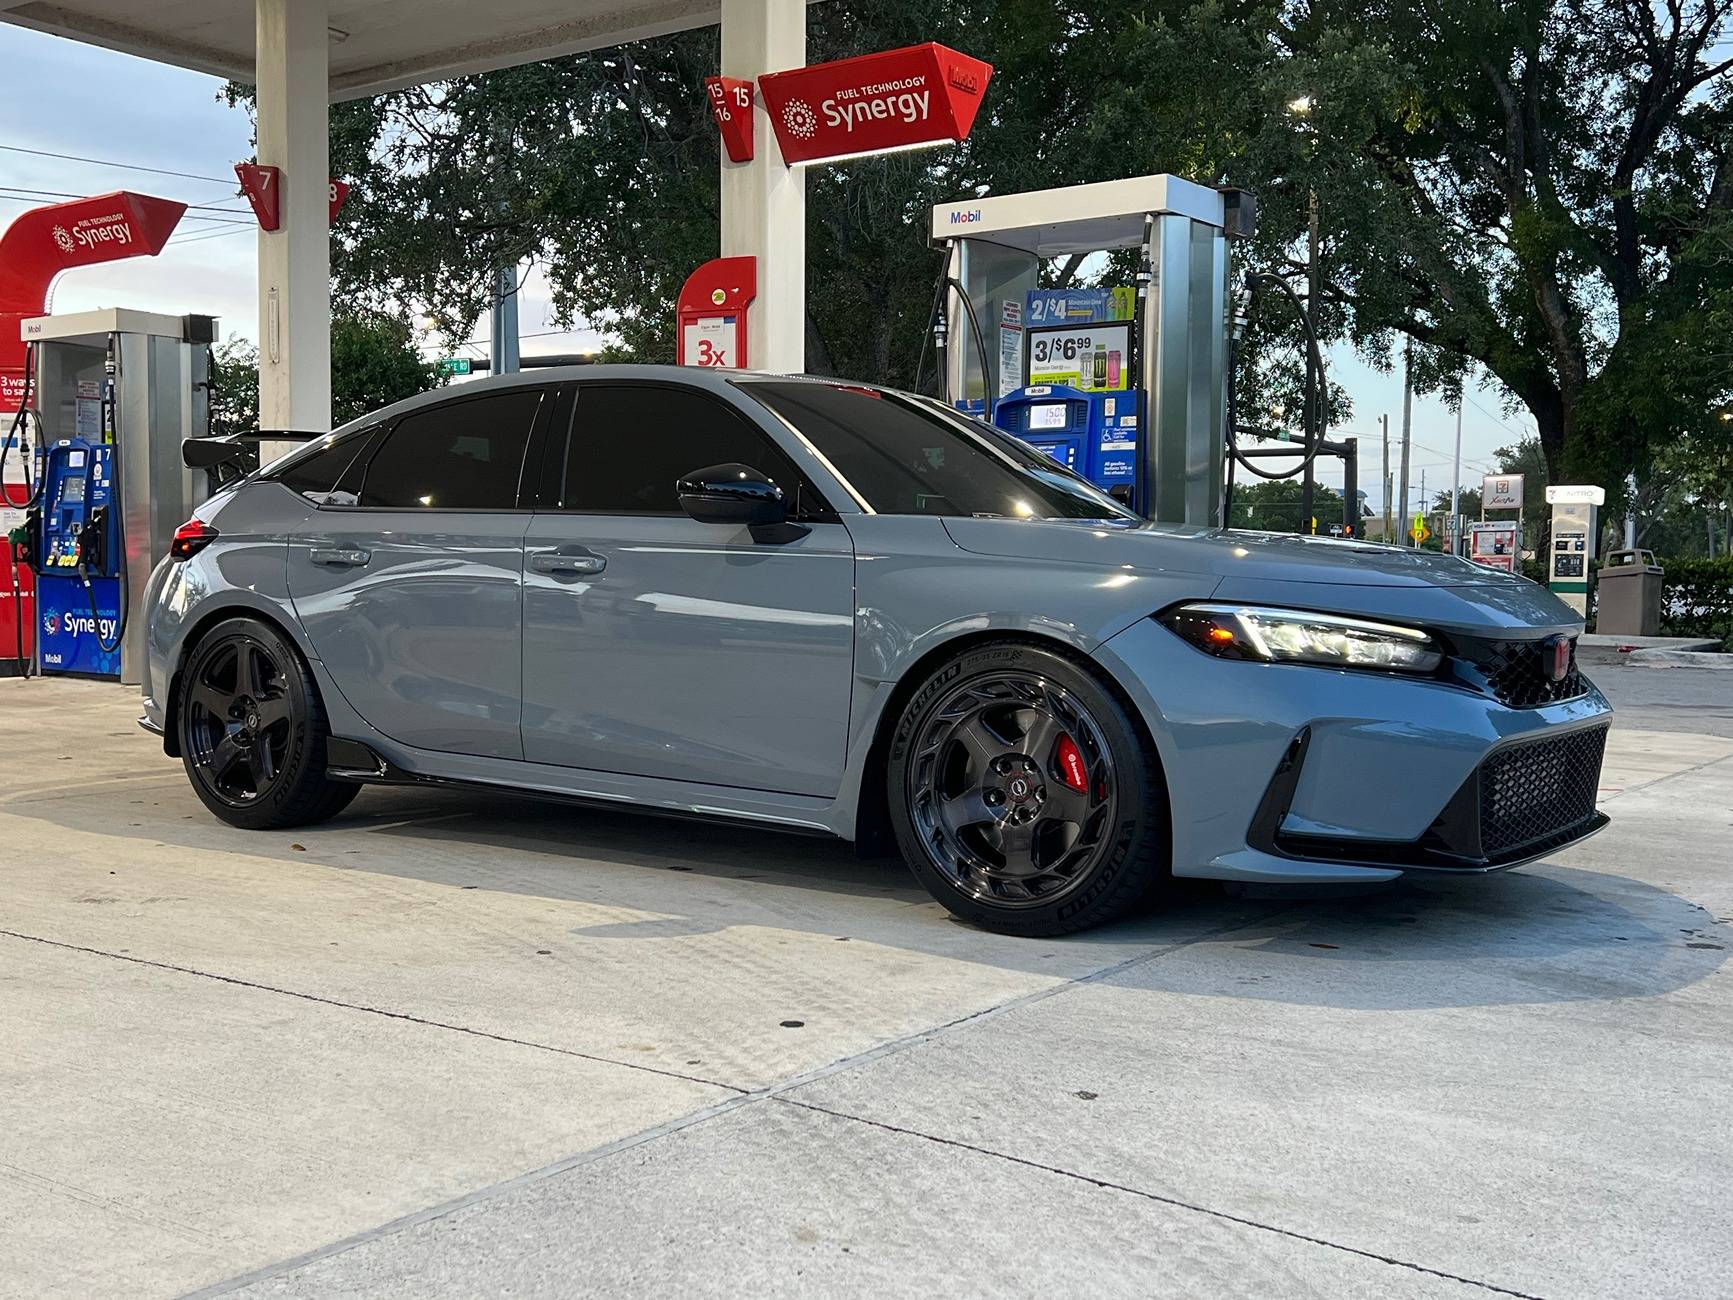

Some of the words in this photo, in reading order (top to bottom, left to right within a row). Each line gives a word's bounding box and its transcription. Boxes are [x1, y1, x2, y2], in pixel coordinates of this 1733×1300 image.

[708, 83, 723, 98] 15
[733, 86, 749, 107] 15
[836, 90, 861, 100] FUEL
[861, 75, 926, 97] TECHNOLOGY
[715, 107, 731, 121] 16
[821, 90, 930, 132] Synergy
[259, 171, 271, 190] 7
[329, 183, 337, 202] 8
[950, 209, 981, 224] Mobil
[72, 222, 132, 249] Synergy
[698, 339, 726, 366] 3x
[1, 376, 8, 386] 3
[105, 449, 110, 461] 7
[64, 612, 117, 639] Synegy
[45, 653, 62, 664] Mobil
[901, 665, 958, 737] MICHELIN
